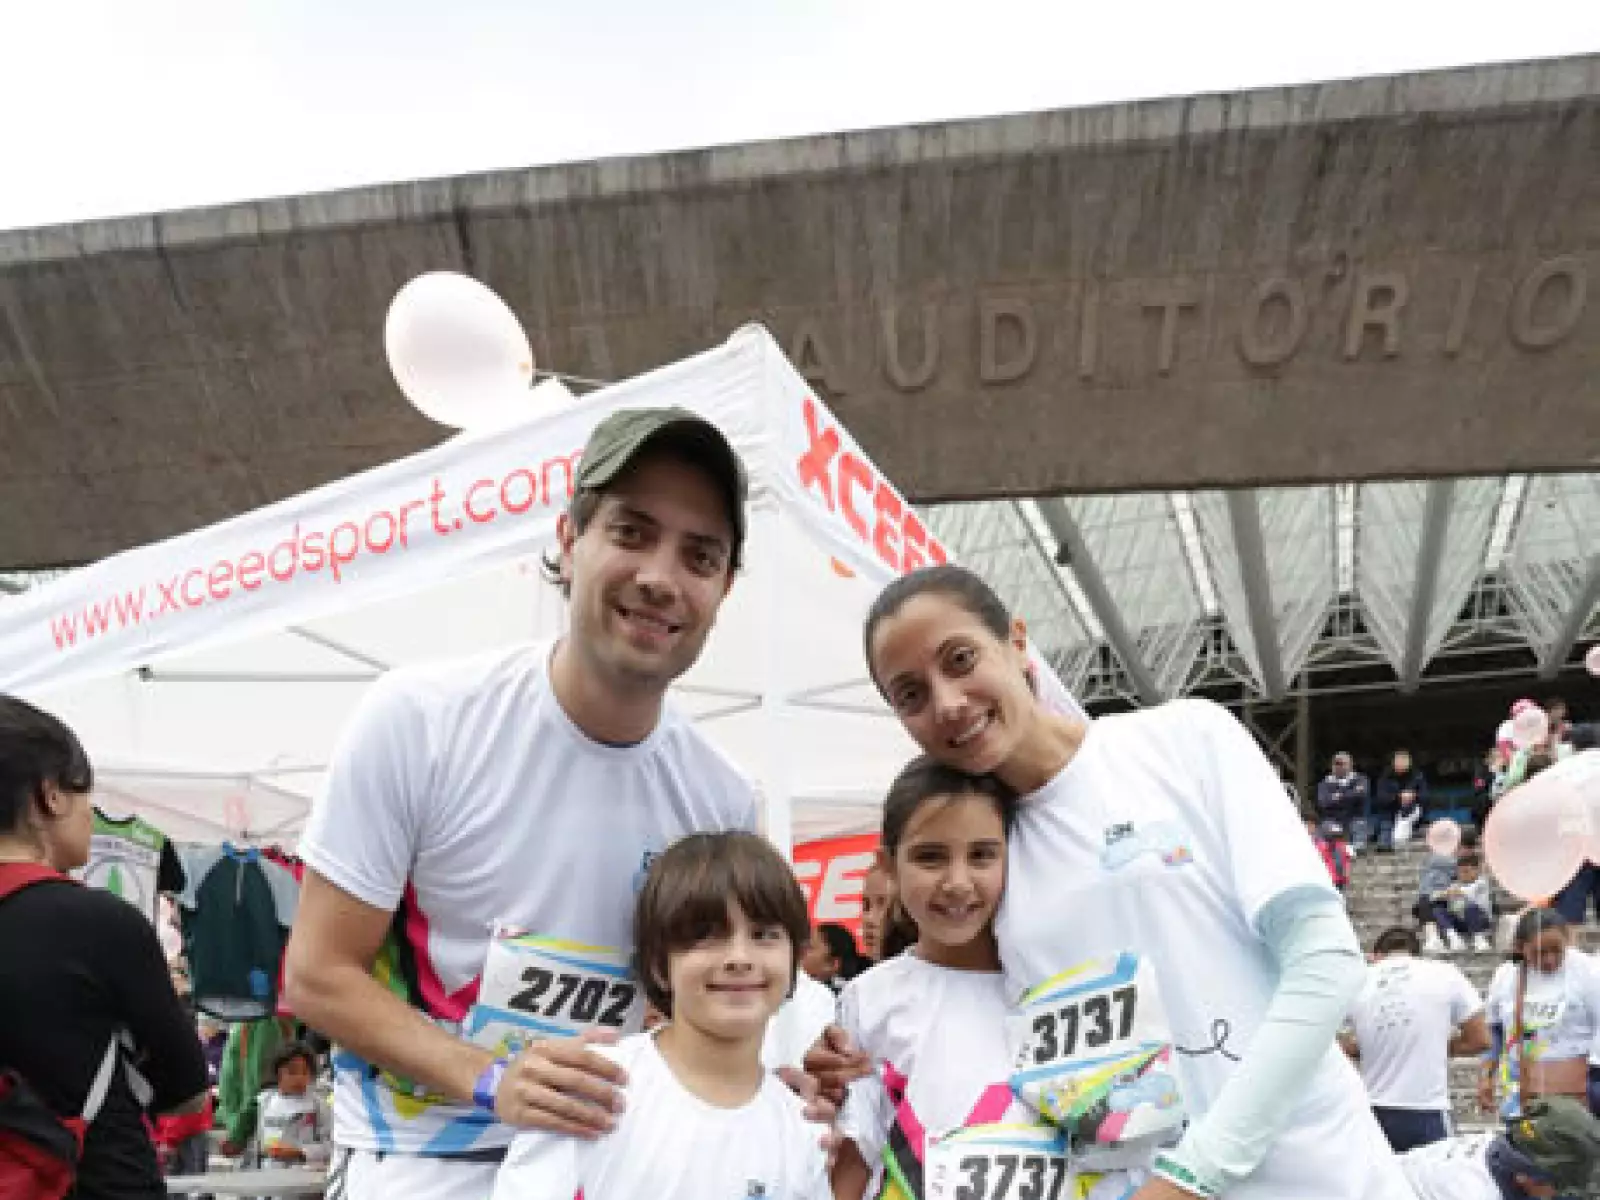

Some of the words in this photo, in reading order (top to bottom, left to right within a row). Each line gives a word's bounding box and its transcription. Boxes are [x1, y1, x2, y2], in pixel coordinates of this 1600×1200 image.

[792, 254, 1590, 398] AUDITORIO
[50, 448, 585, 650] www.xceedsport.com
[508, 966, 636, 1027] 2702
[1032, 984, 1137, 1065] 3737
